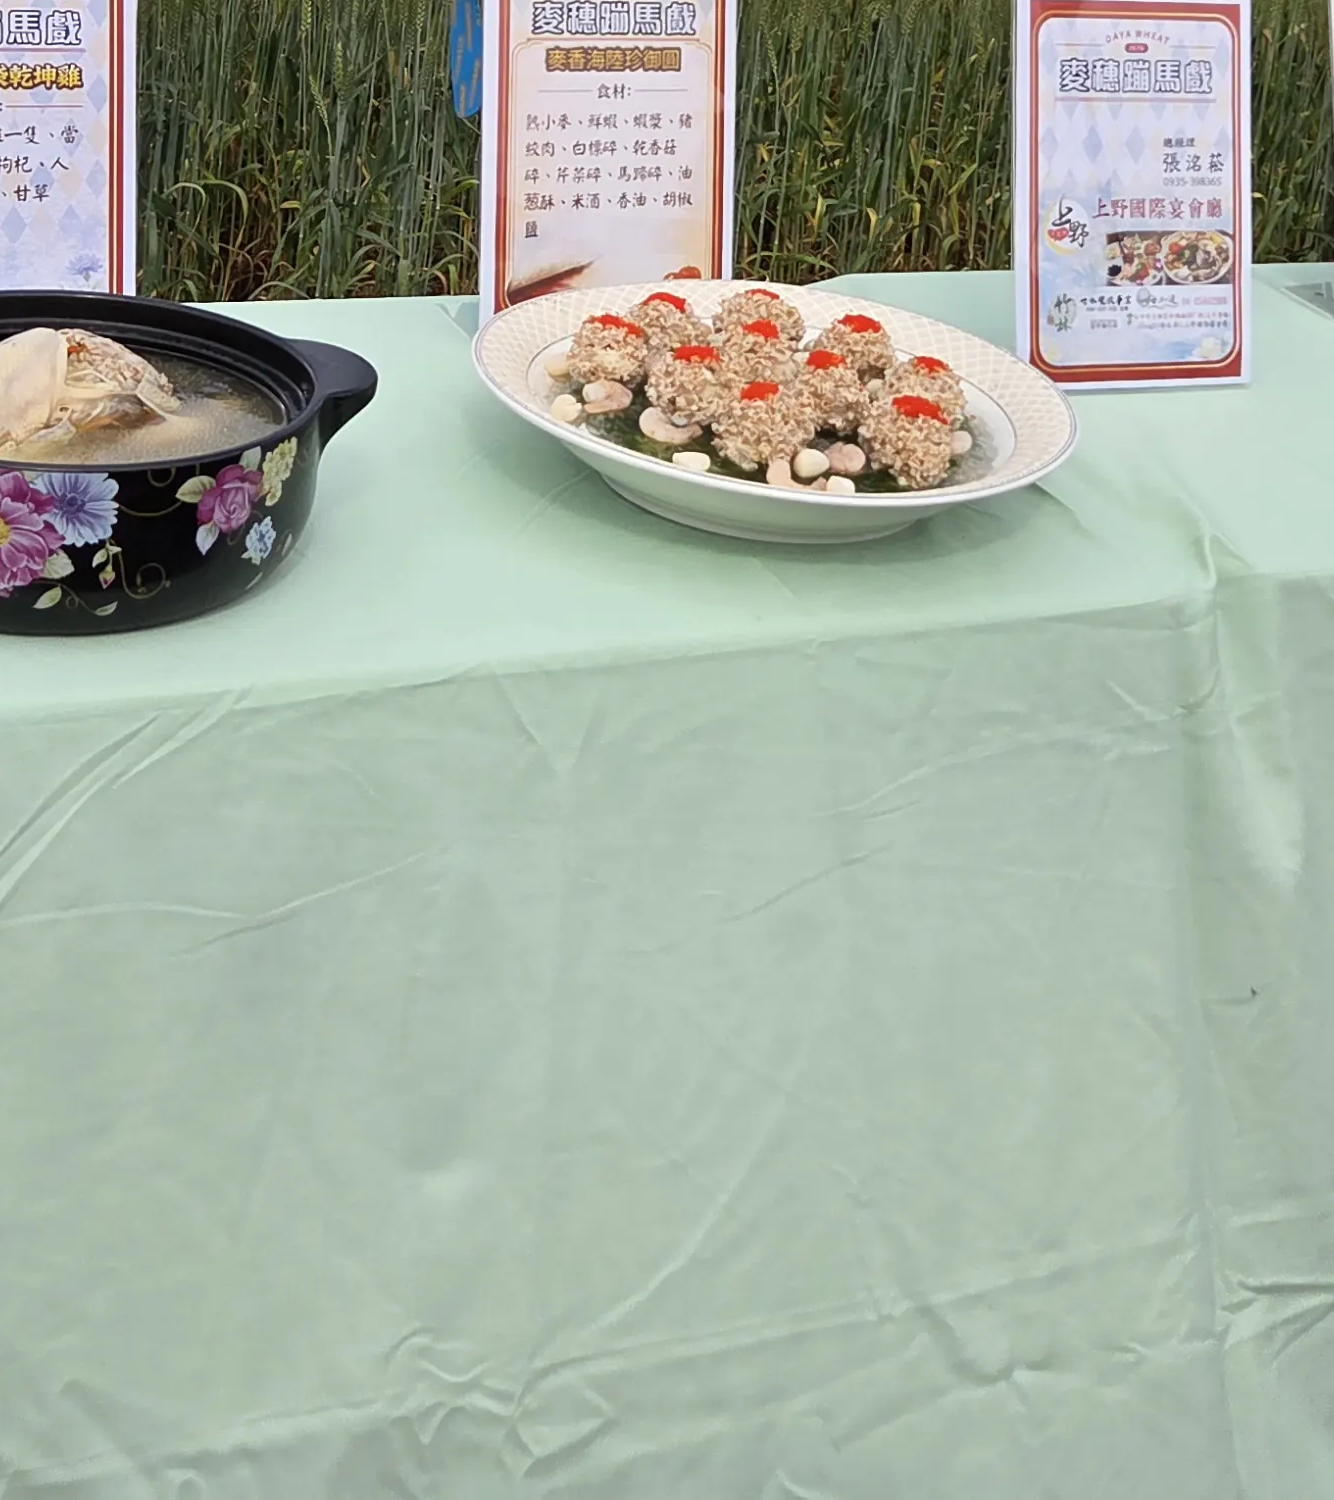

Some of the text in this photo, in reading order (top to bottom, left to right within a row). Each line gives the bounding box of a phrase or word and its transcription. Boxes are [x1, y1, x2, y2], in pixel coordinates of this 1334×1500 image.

[531, 0, 696, 36] 麥穗蹦馬戲
[1105, 30, 1171, 44] DAYA WHEAT
[1059, 57, 1212, 94] 麥穗蹦馬戲
